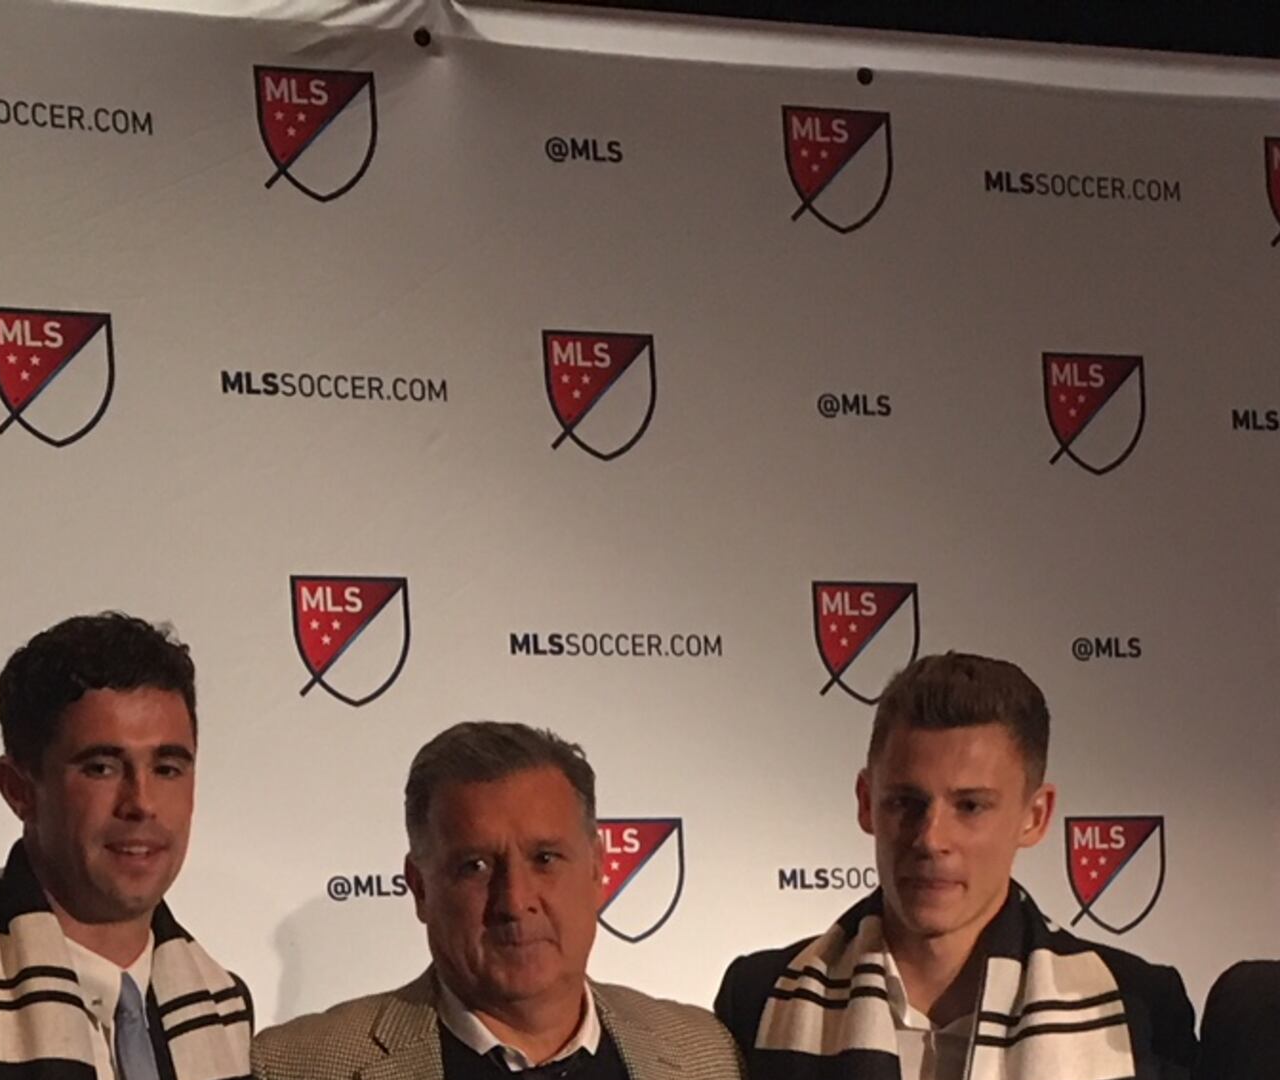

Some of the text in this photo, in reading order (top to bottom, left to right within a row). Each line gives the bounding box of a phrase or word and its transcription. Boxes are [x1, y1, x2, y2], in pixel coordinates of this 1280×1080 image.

[265, 76, 329, 106] MLS
[791, 115, 849, 144] MLS
[544, 136, 624, 164] @MLS
[984, 170, 1181, 202] MLSSOCCER.COM
[552, 340, 611, 368] MLS
[220, 370, 448, 402] MLSSOCCER.COM
[1051, 362, 1105, 388] MLS
[817, 393, 892, 419] @MLS
[301, 586, 363, 613] MLS
[821, 591, 877, 616] MLS
[509, 633, 723, 657] MLSSOCCER.COM
[1071, 636, 1142, 662] @MLS
[596, 829, 640, 853] LS
[1073, 825, 1126, 850] MLS
[327, 875, 406, 902] @MLS
